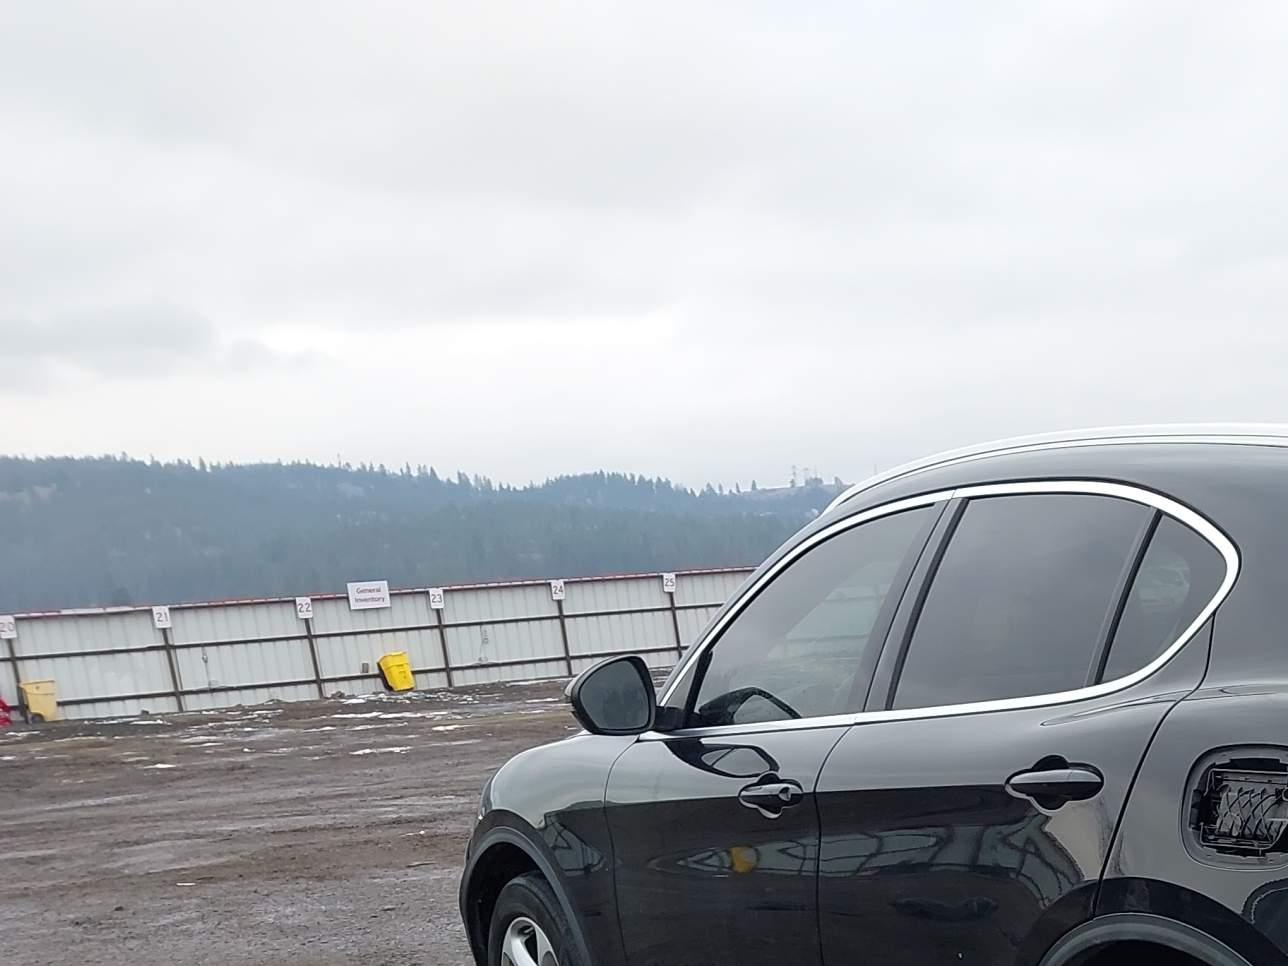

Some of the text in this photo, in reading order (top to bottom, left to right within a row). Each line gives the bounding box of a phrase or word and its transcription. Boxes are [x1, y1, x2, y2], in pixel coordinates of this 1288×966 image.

[664, 577, 675, 587] 25
[355, 586, 382, 595] General
[552, 585, 564, 595] 24
[431, 593, 443, 604] 23
[297, 602, 312, 613] 22
[156, 612, 169, 623] 21
